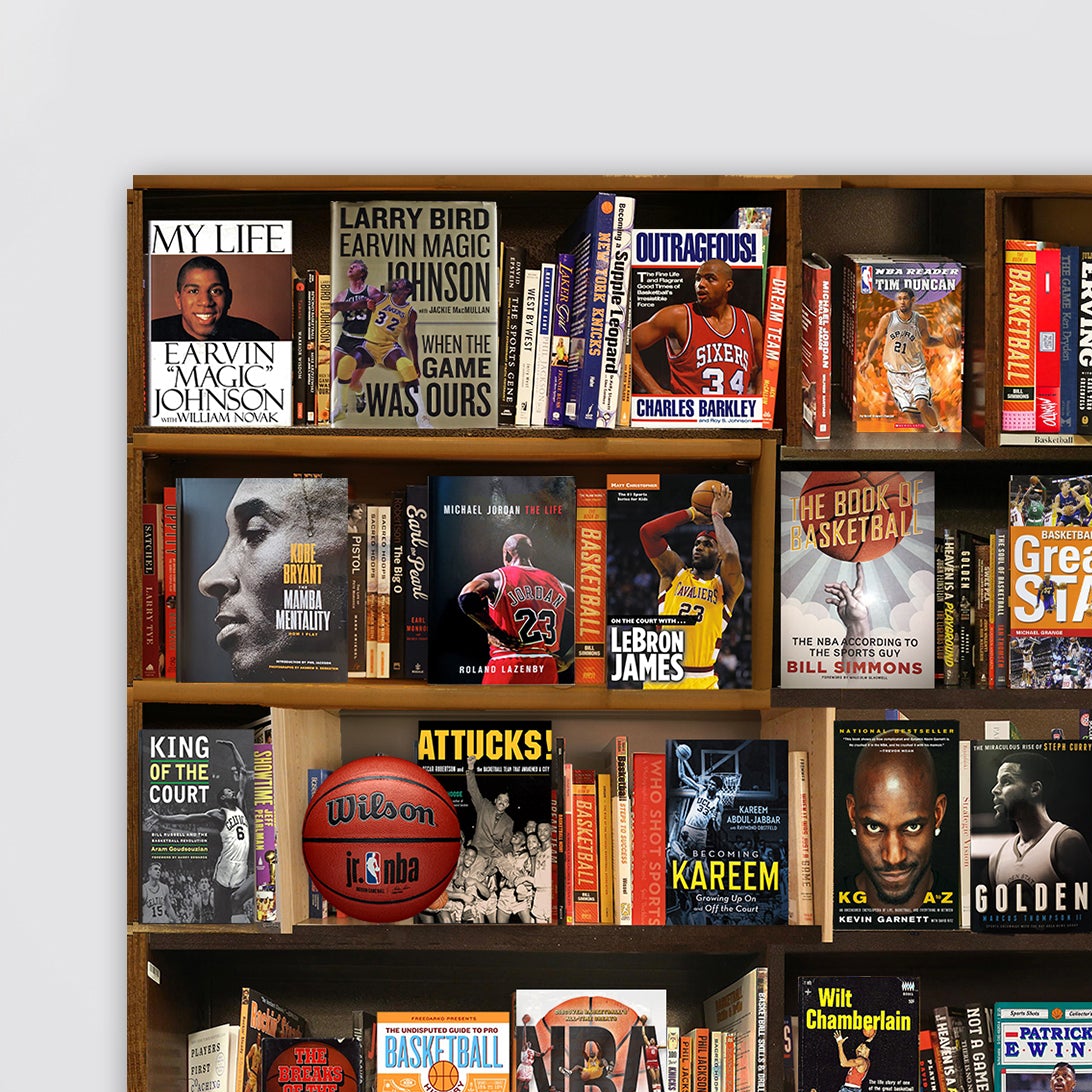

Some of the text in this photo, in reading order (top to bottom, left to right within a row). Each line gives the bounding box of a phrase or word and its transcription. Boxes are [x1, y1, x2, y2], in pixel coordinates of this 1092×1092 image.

[340, 208, 490, 229] LARRY BIRD
[153, 224, 285, 253] MY LIFE
[340, 234, 490, 257] EARVIN MAGIC
[637, 232, 756, 262] OUTRAGEOUS!
[588, 232, 610, 356] NEW YORK KNICKS
[876, 279, 956, 290] TIM DUNCAN
[165, 343, 274, 365] EARVIN
[422, 335, 491, 353] WHEN THE
[422, 358, 491, 378] GAME
[153, 389, 284, 418] JOHNSON
[366, 384, 491, 418] WAS OURS
[637, 400, 756, 417] CHARLES BARKLEY
[177, 413, 278, 423] WILLIAM NOVAK
[444, 505, 563, 515] MICHAEL JORDAN THE LIFE
[790, 480, 922, 522] THE BOOK OF
[790, 510, 923, 551] BASKETBALL
[290, 544, 316, 563] KOBE
[284, 564, 322, 584] BRYANT
[284, 590, 322, 610] MAMBA
[276, 611, 331, 630] MENTALITY
[792, 637, 918, 646] THE NBA ACCORDING TO
[810, 649, 900, 657] THE SPORTS GUY
[459, 665, 544, 674] ROLAND LAZENBY
[611, 655, 684, 682] JAMES
[787, 662, 922, 674] BILL SIMMONS
[150, 736, 209, 758] KING
[418, 730, 552, 760] ATTUCKS!
[150, 764, 209, 780] OF THE
[150, 786, 209, 804] COURT
[326, 792, 434, 827] Wilson
[739, 806, 768, 814] KAREEM
[726, 816, 781, 824] ABDUL-JABBAR
[693, 850, 759, 858] BECOMING
[346, 851, 418, 887] jr. nba
[672, 861, 778, 890] KAREEM
[839, 892, 867, 903] KG
[976, 882, 1088, 913] GOLDEN
[818, 988, 852, 1008] Wilt
[806, 1010, 910, 1031] Chamberlain
[295, 1048, 327, 1065] THE
[386, 1037, 503, 1069] BASKETBALL
[278, 1066, 342, 1082] BREAKS
